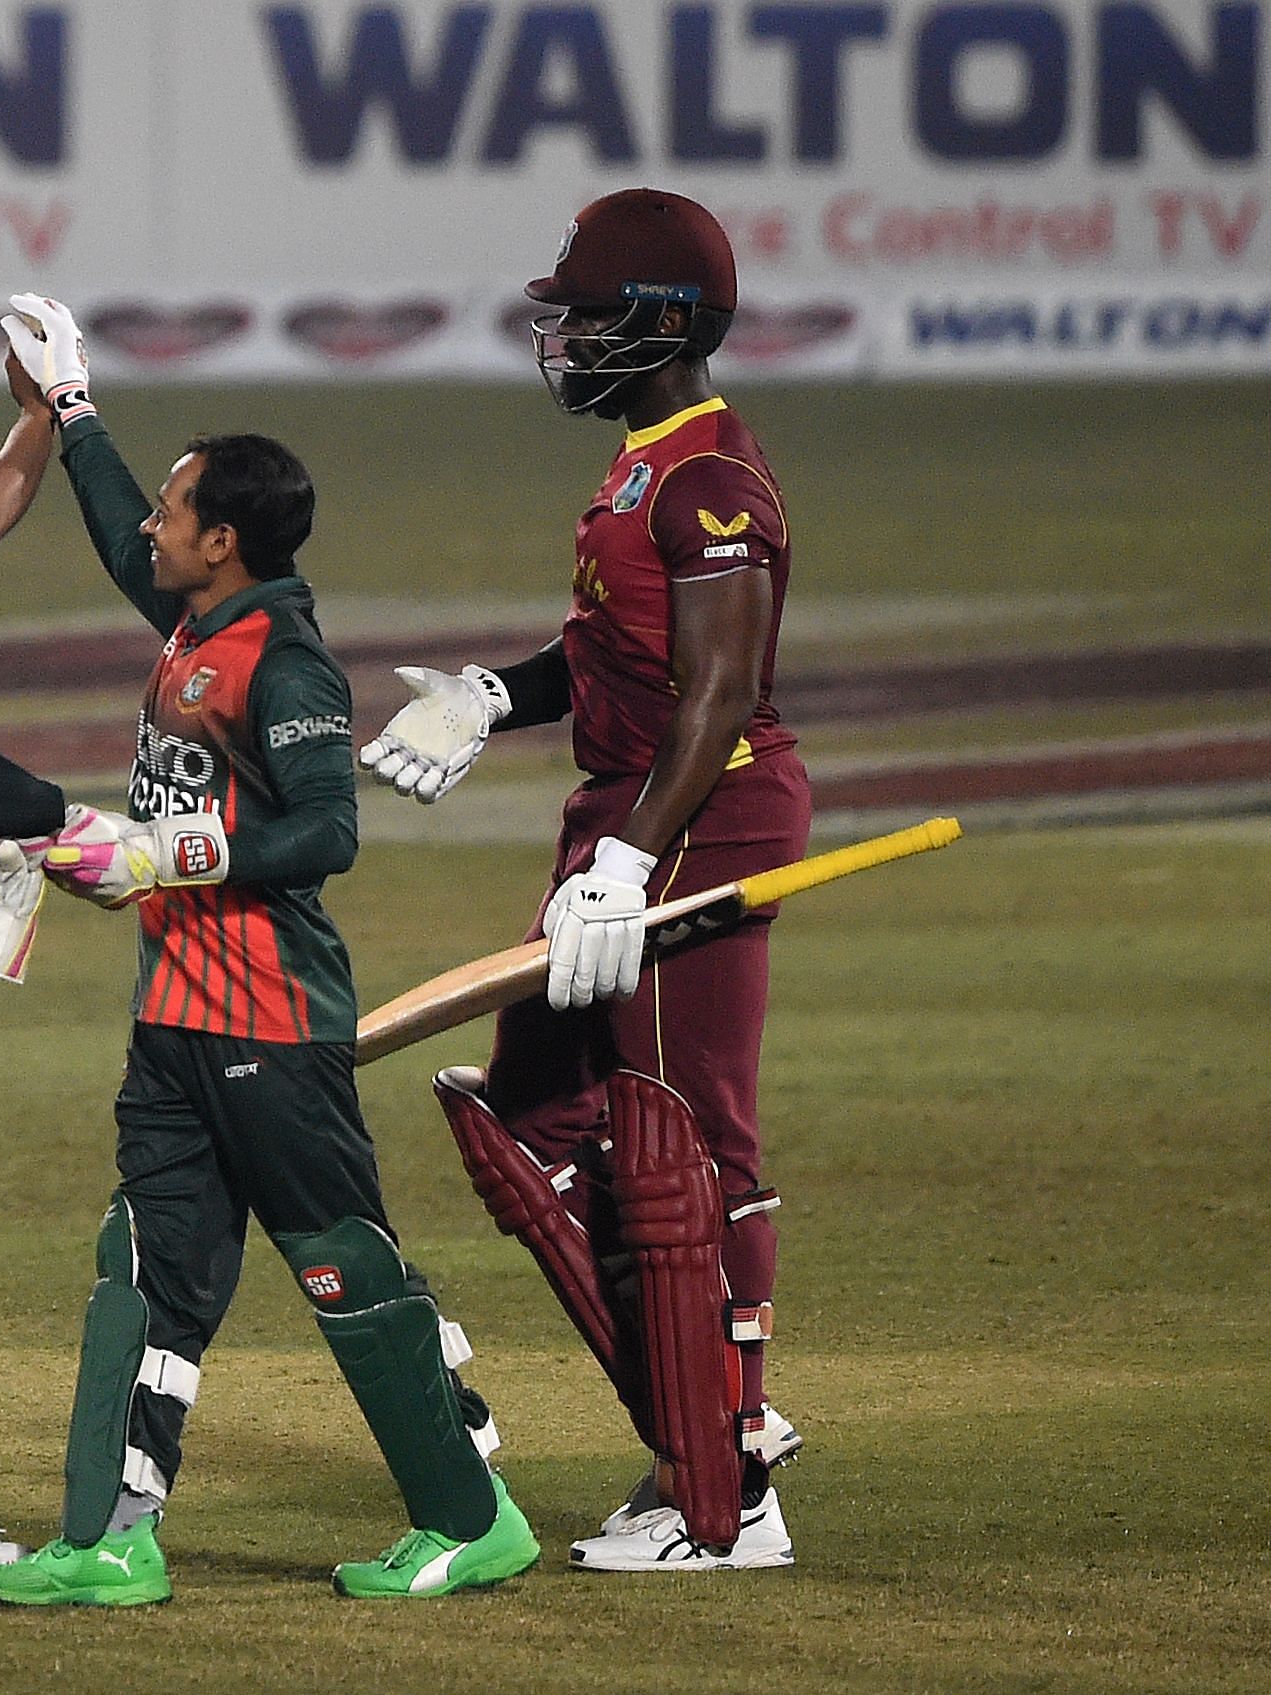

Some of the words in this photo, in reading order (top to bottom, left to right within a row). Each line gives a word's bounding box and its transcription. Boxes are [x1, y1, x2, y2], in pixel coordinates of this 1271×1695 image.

[259, 0, 1270, 174] WALTON
[1151, 190, 1260, 260] TV
[910, 301, 1271, 349] WALTON
[184, 838, 208, 872] SS
[307, 1273, 341, 1296] SS
